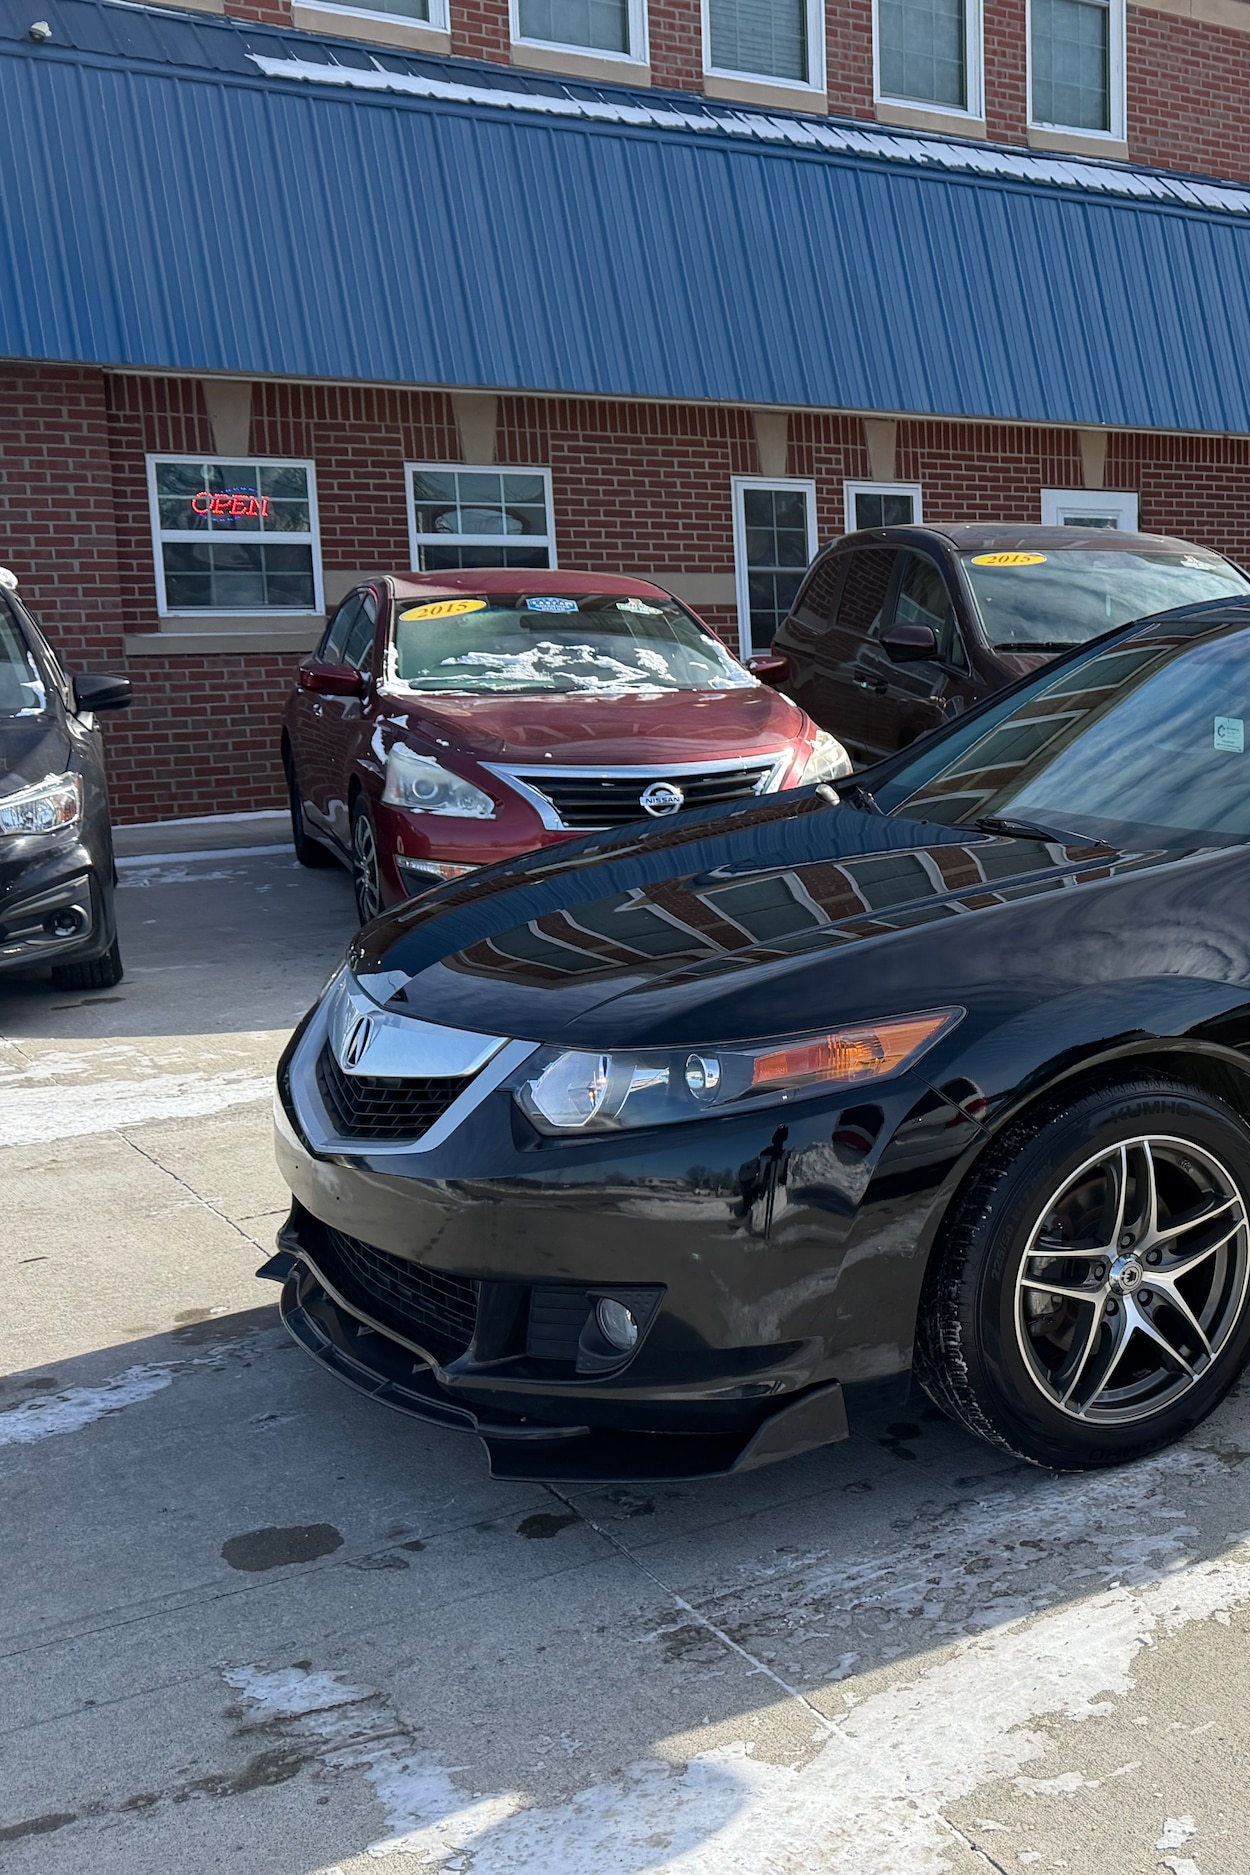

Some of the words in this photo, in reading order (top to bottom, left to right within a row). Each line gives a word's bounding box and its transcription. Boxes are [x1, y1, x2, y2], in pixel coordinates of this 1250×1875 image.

[191, 491, 270, 518] OPEN
[986, 552, 1031, 565] 2015
[416, 600, 469, 619] 2015
[645, 796, 680, 804] NISSAN
[1110, 1100, 1192, 1124] KUMHO
